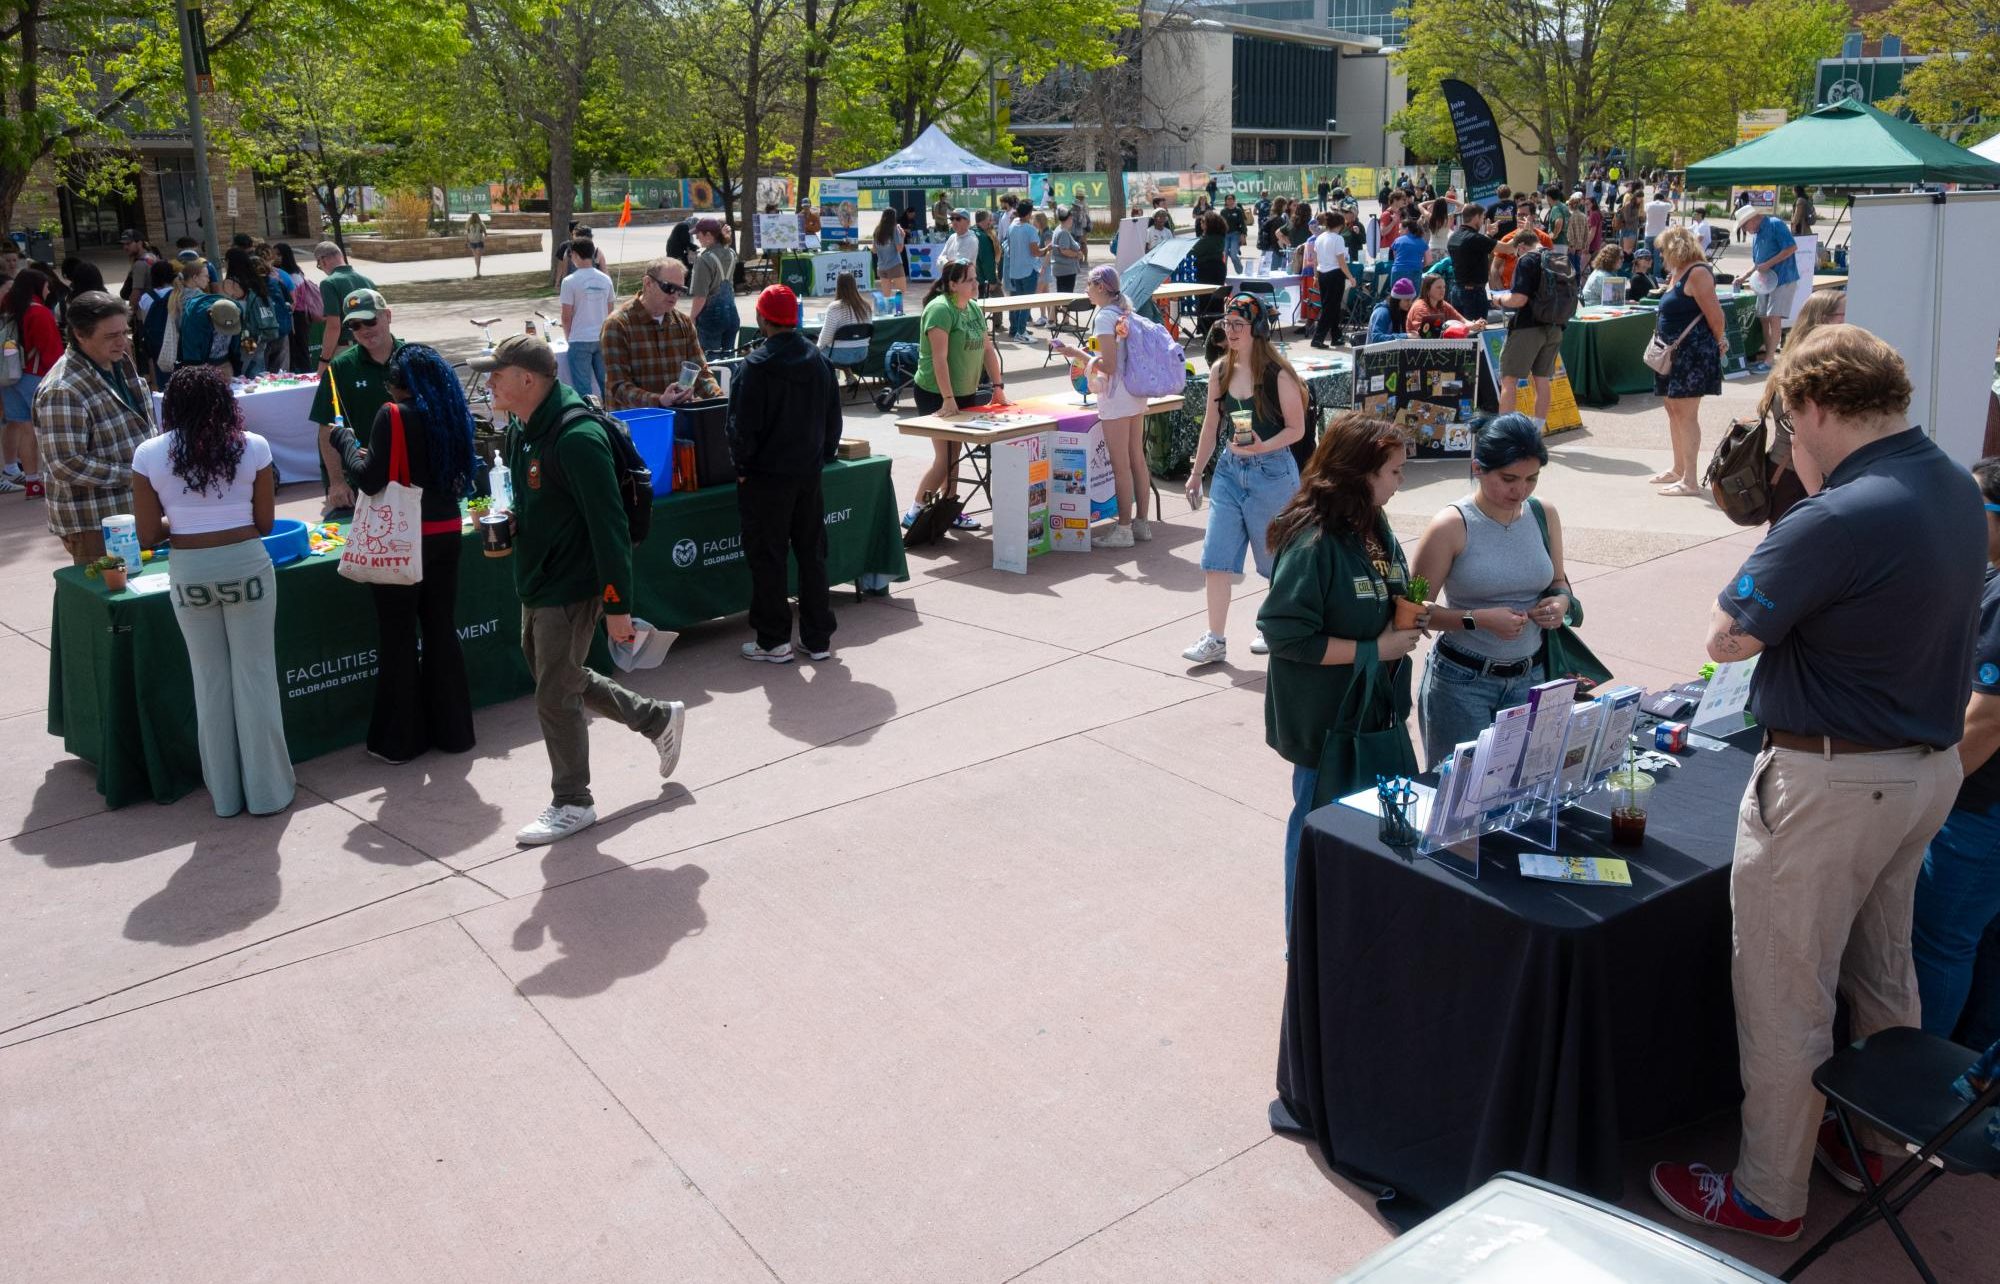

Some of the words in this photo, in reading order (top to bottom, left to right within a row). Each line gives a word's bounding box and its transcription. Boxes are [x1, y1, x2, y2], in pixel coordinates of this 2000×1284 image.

[1450, 100, 1466, 111] Join
[1453, 111, 1465, 119] the
[1455, 115, 1478, 127] student
[1457, 120, 1490, 134] community
[1460, 140, 1485, 150] outdoor
[1462, 144, 1497, 158] enthusiasts
[1404, 349, 1476, 367] WASTE
[702, 535, 743, 554] FACILI
[343, 552, 367, 566] ELLO
[371, 556, 411, 568] KITTY
[703, 552, 739, 567] COLORADO
[175, 575, 264, 608] 1950
[286, 649, 378, 685] FACILITIES
[288, 678, 339, 699] COLORADO
[341, 670, 369, 685] STATE
